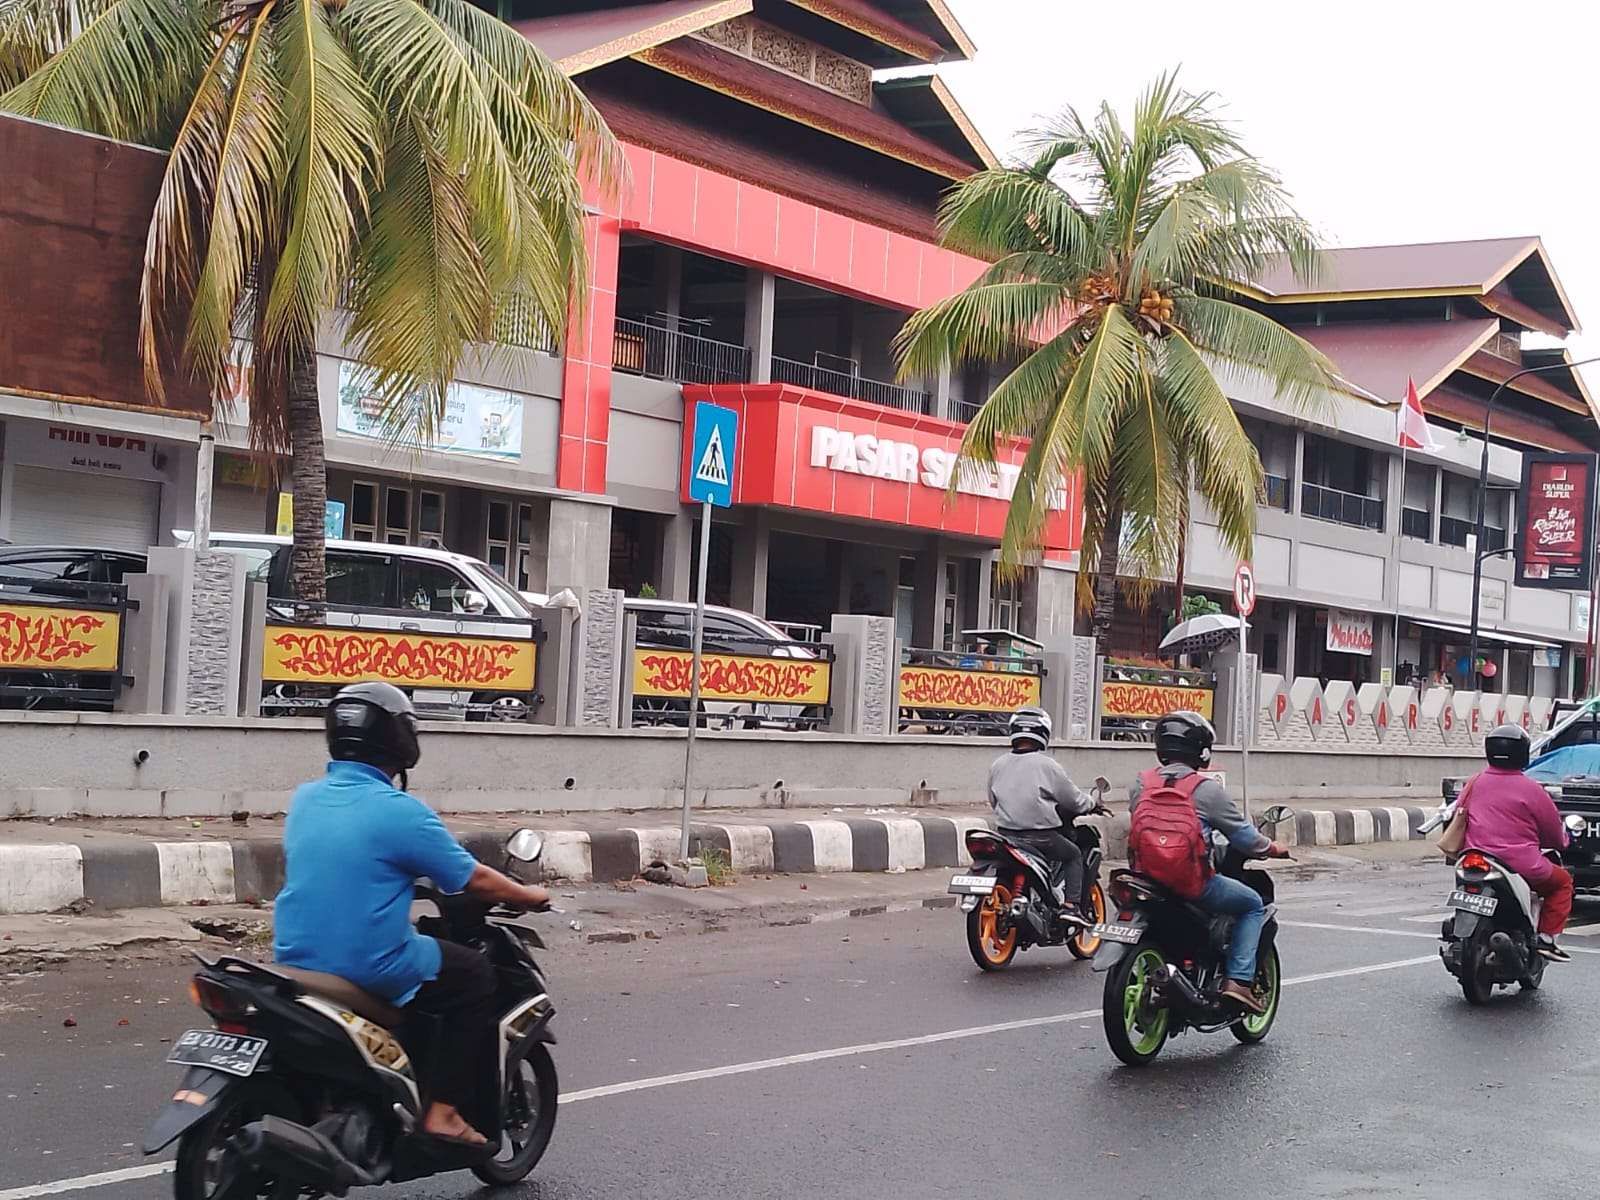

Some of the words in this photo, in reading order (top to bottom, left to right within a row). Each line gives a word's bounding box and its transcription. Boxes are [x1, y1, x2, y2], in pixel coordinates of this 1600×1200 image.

[809, 425, 919, 484] PASAR
[1275, 693, 1417, 731] PASAR
[200, 1034, 238, 1050] 2173
